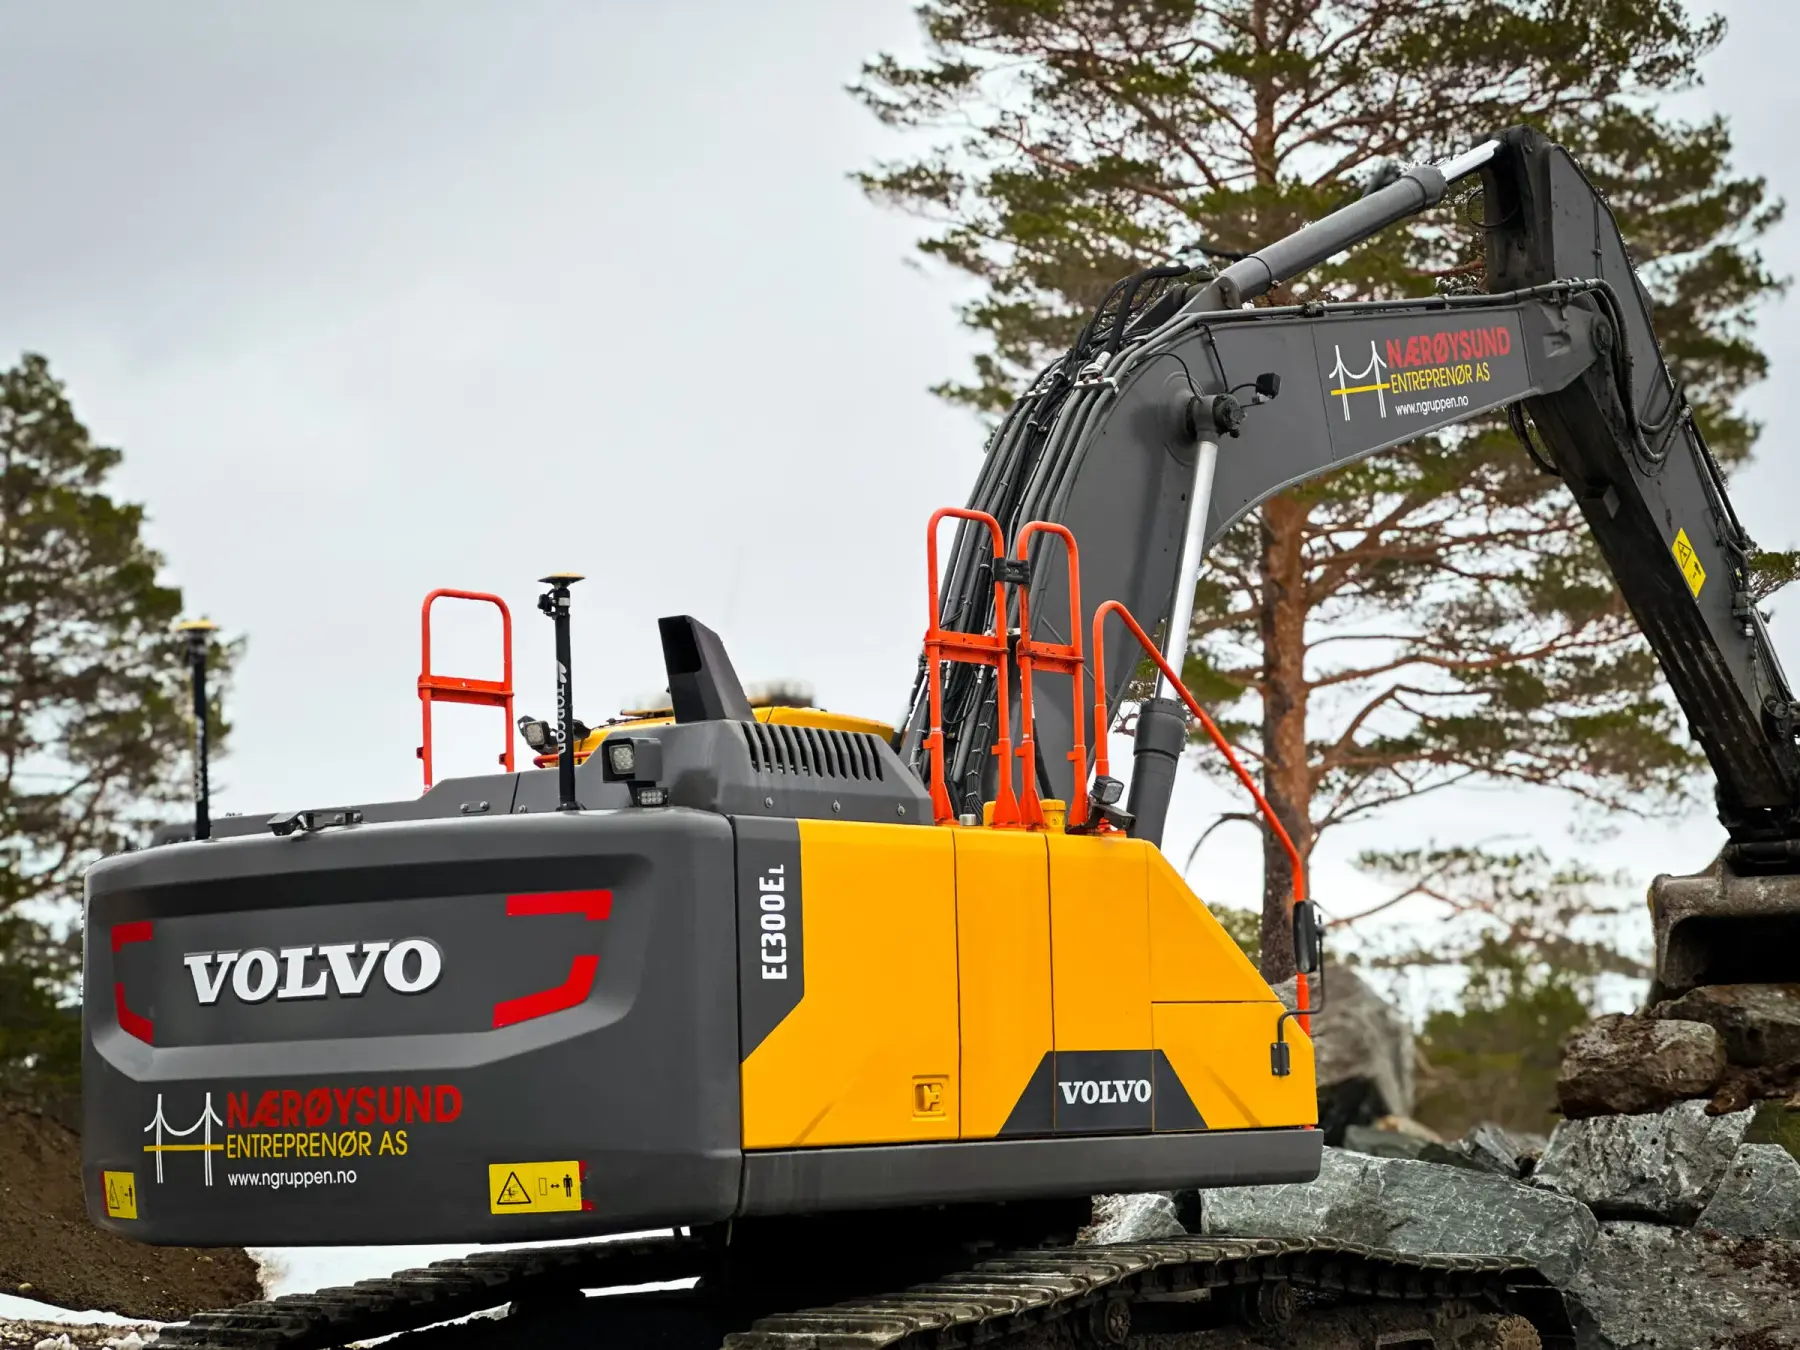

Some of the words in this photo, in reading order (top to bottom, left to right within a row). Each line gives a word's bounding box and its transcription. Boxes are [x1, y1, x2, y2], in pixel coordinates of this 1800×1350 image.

[1387, 327, 1511, 368] NÆRØYSUND
[1390, 365, 1473, 394] ENTREPRENØR
[1475, 362, 1490, 382] AS
[1395, 394, 1468, 415] www.ngruppen.no
[184, 938, 442, 1004] VOLVO
[226, 1084, 463, 1128] NÆRØYSUND
[1059, 1079, 1152, 1104] VOLVO
[227, 1131, 372, 1158] ENTREPRENØR
[378, 1130, 408, 1157] AS
[228, 1169, 357, 1189] www.ngruppen.no
